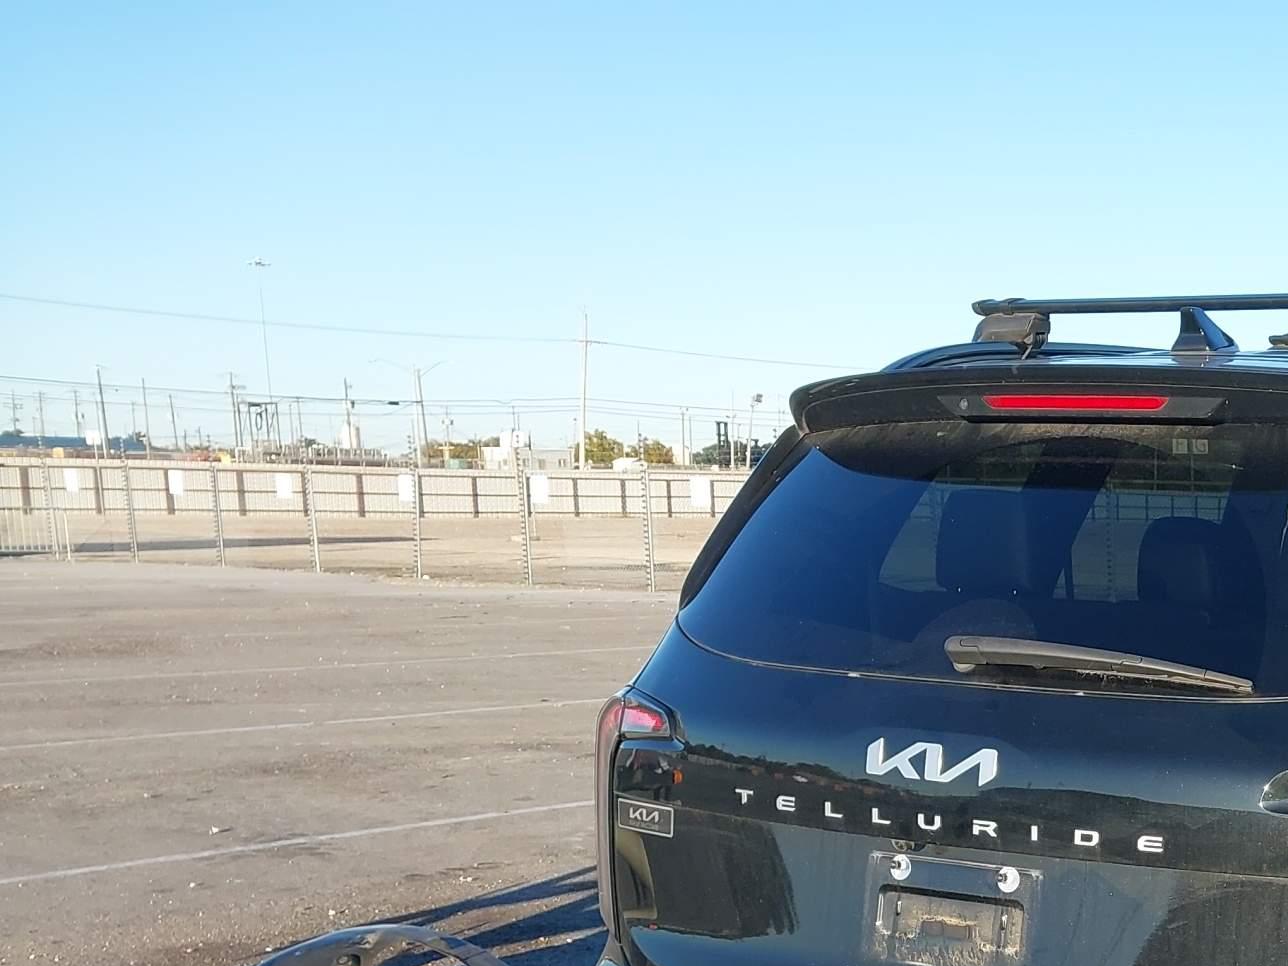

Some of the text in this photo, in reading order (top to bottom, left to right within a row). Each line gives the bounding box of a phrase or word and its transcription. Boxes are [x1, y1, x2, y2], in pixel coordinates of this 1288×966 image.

[866, 738, 998, 787] KIA
[629, 807, 660, 823] KIA
[734, 788, 1164, 853] TELLURIDE
